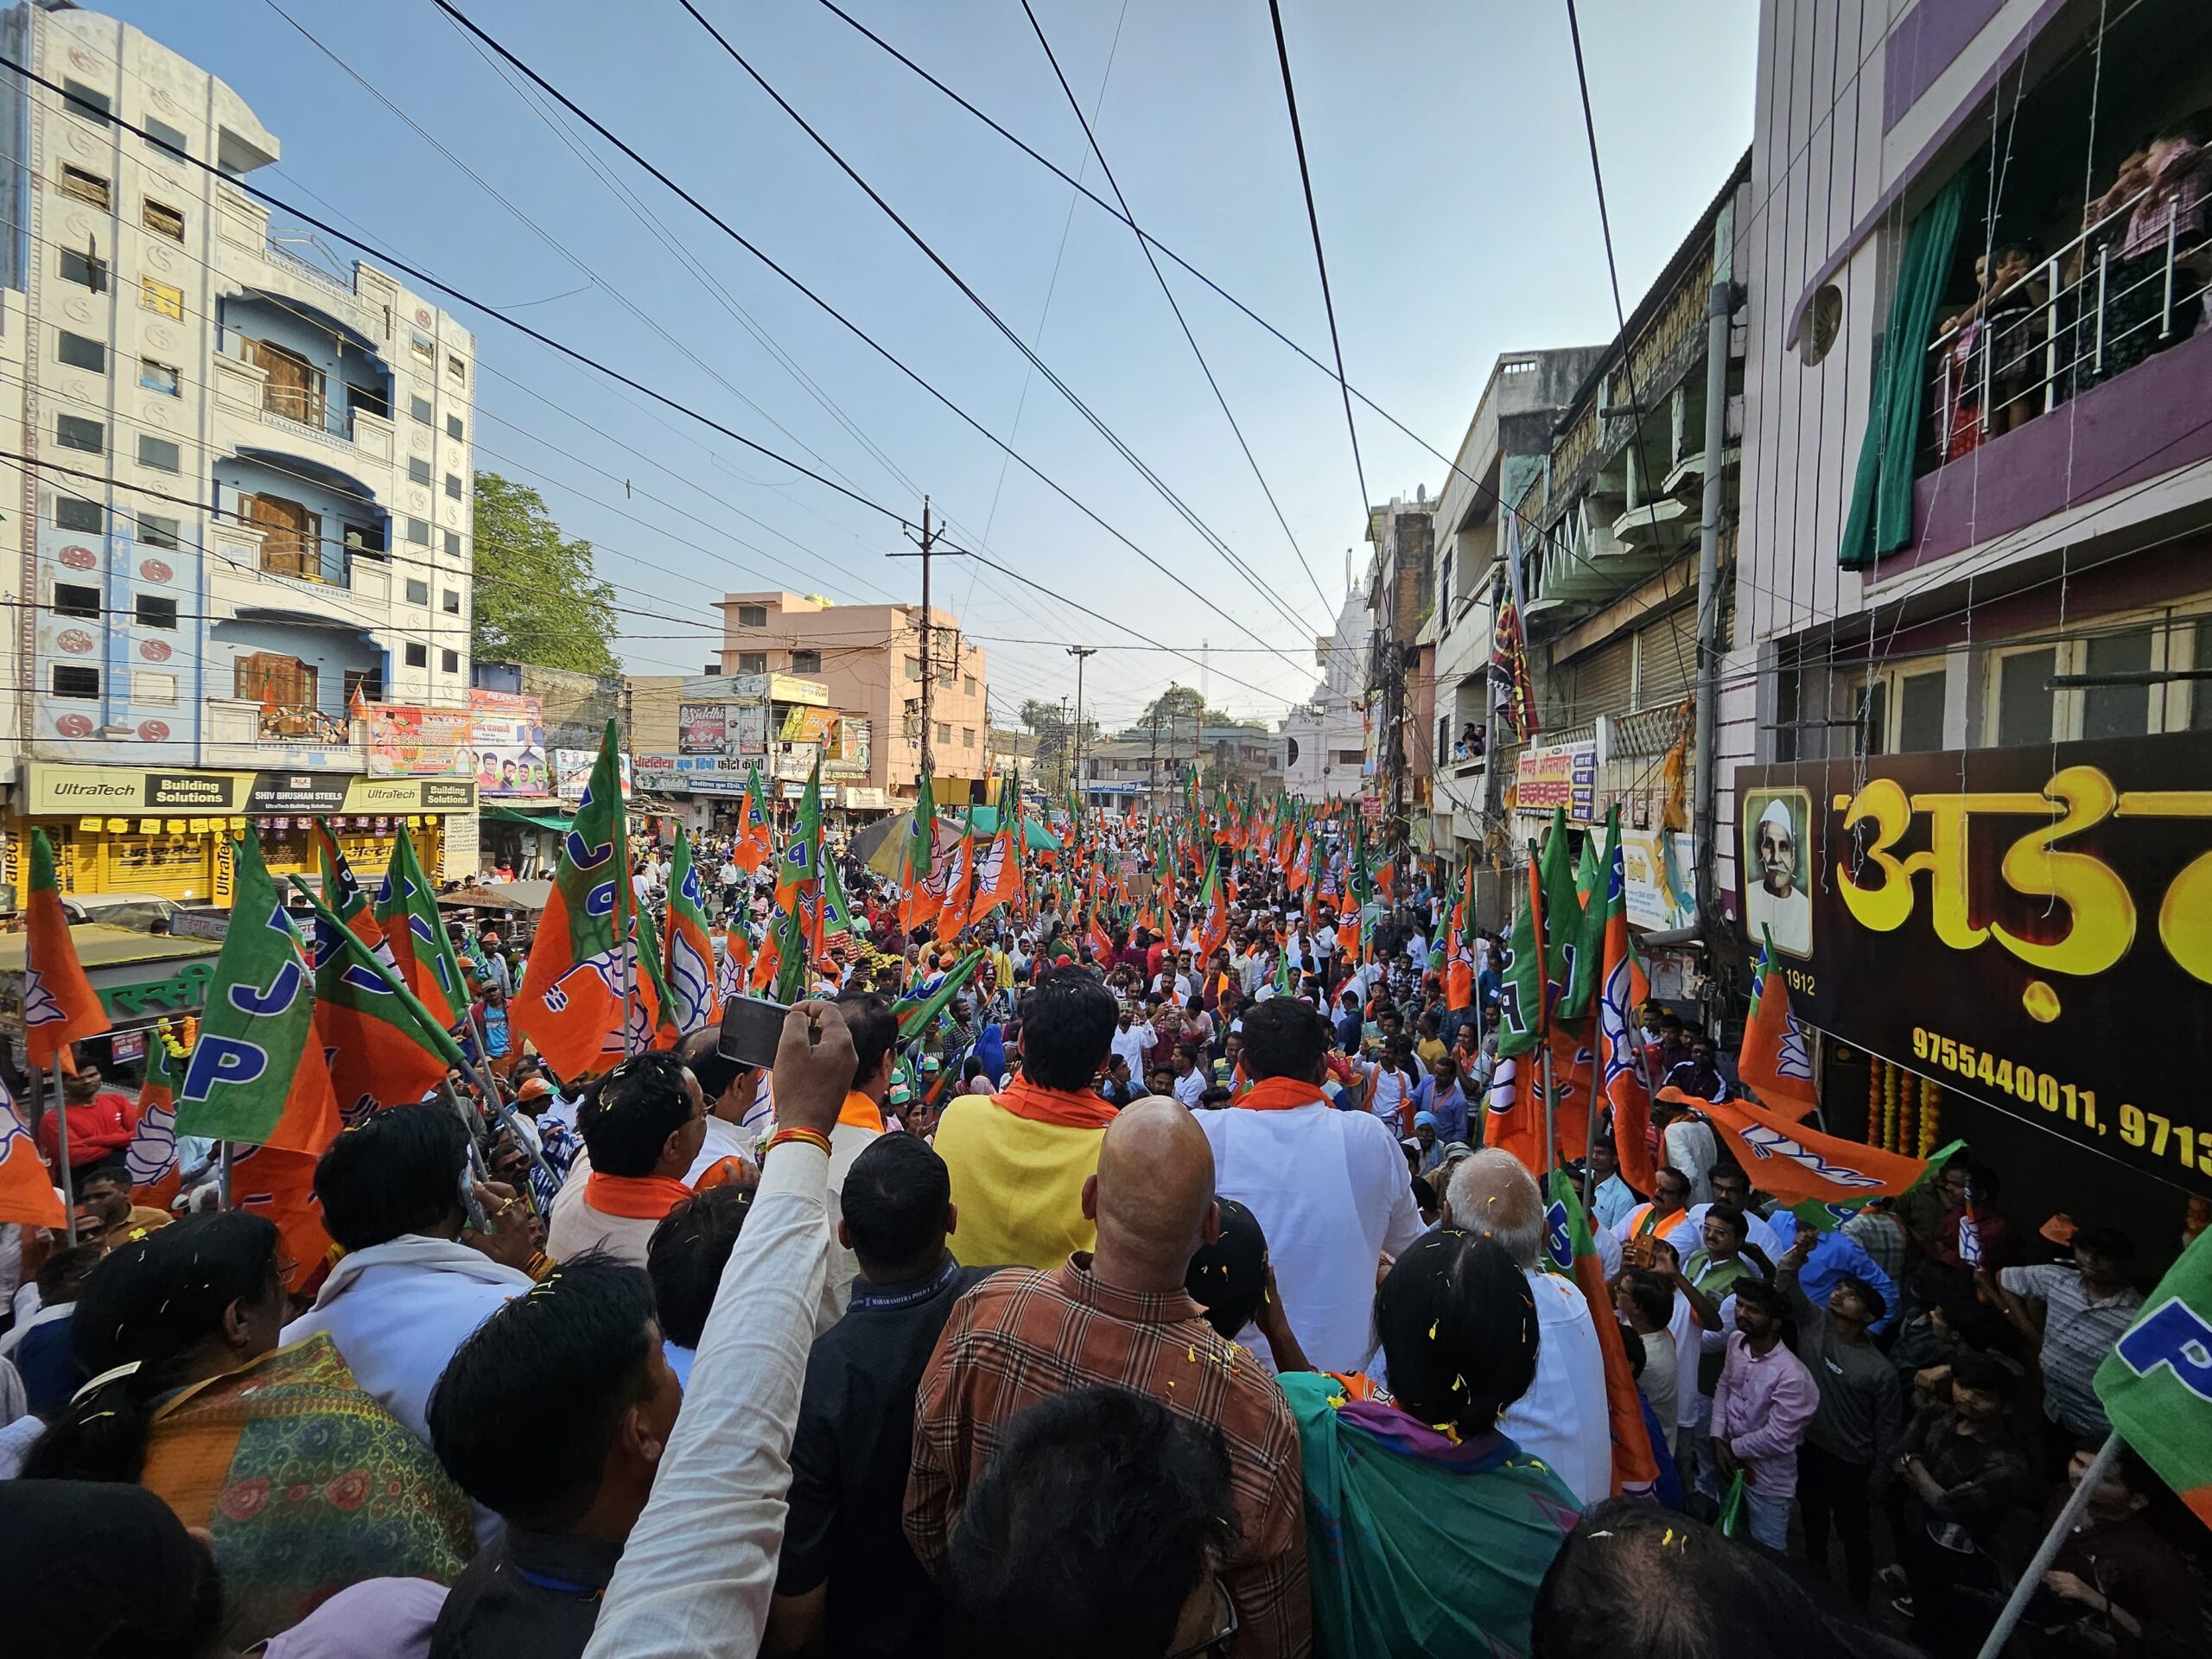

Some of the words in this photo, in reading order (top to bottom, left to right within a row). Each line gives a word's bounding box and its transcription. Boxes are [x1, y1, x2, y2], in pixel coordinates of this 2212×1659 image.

[687, 707, 725, 724] Siddhi
[677, 758, 692, 772] बुक
[696, 757, 715, 771] डिपो
[717, 757, 740, 771] फोटो
[54, 783, 136, 797] UltraTech
[161, 779, 219, 793] Building
[429, 785, 466, 797] Building
[156, 791, 224, 804] Solutions
[255, 791, 275, 800] SHIV
[276, 791, 314, 800] BHUSHAN
[315, 791, 343, 801] STEELS
[367, 789, 415, 799] UltraTech
[427, 795, 468, 804] Solutions
[1786, 968, 1815, 996] 1912
[1912, 1027, 2107, 1136] 9755440011,
